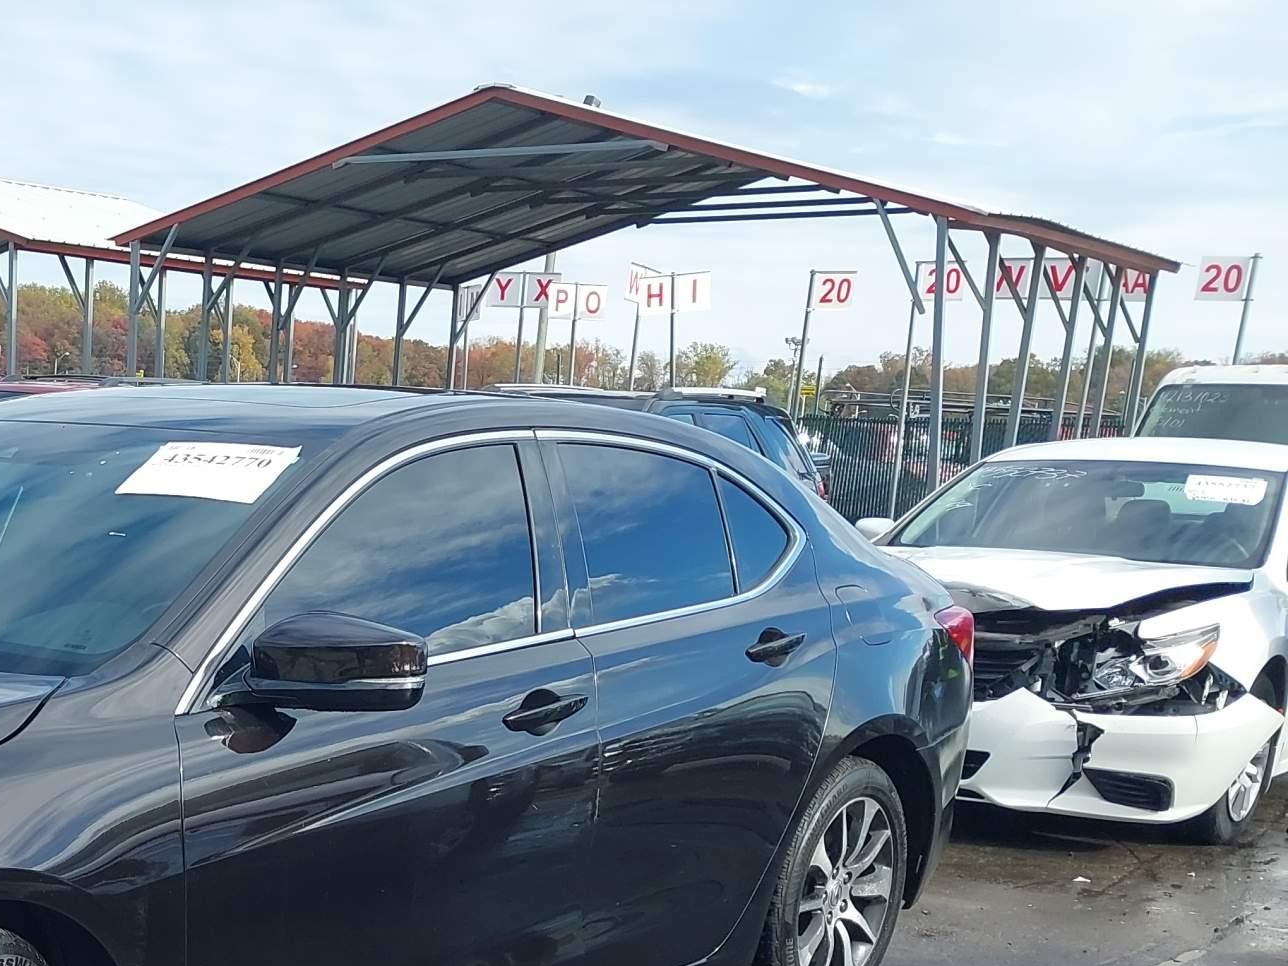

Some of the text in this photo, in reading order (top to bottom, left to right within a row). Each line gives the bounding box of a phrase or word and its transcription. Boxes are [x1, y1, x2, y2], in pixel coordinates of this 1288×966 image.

[495, 278, 552, 301] Y X
[819, 278, 852, 303] 20
[926, 268, 961, 294] 20
[1200, 264, 1243, 293] 20
[555, 289, 601, 314] P O
[646, 279, 698, 308] H I
[163, 453, 272, 468] 43542770
